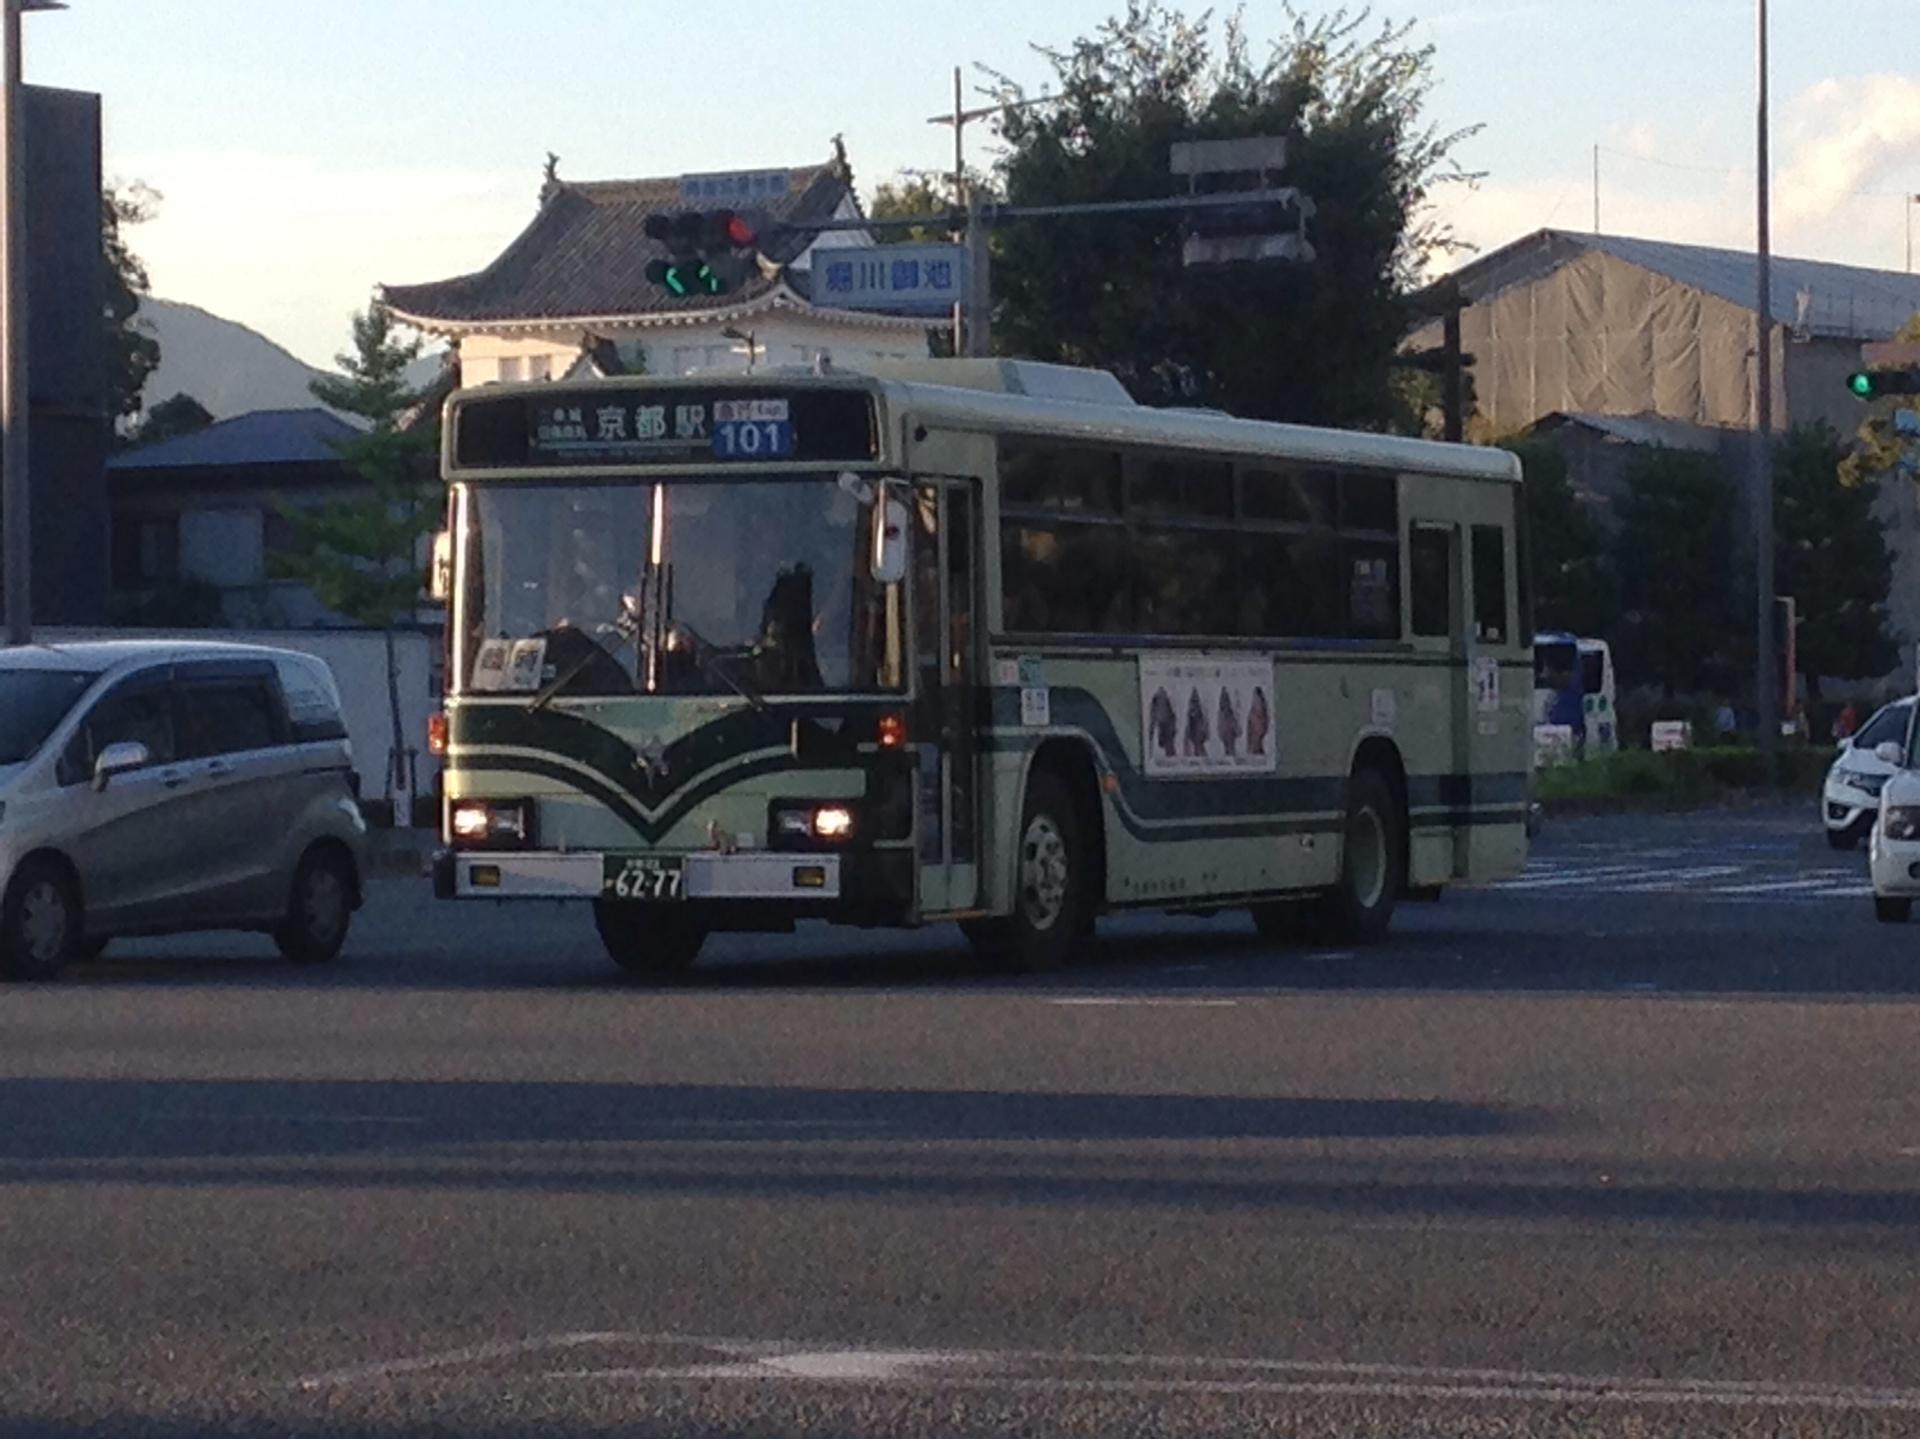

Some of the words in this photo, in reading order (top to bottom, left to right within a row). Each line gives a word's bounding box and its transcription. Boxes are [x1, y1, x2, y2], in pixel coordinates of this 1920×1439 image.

[596, 404, 706, 440] 京都駅
[720, 422, 779, 454] 101
